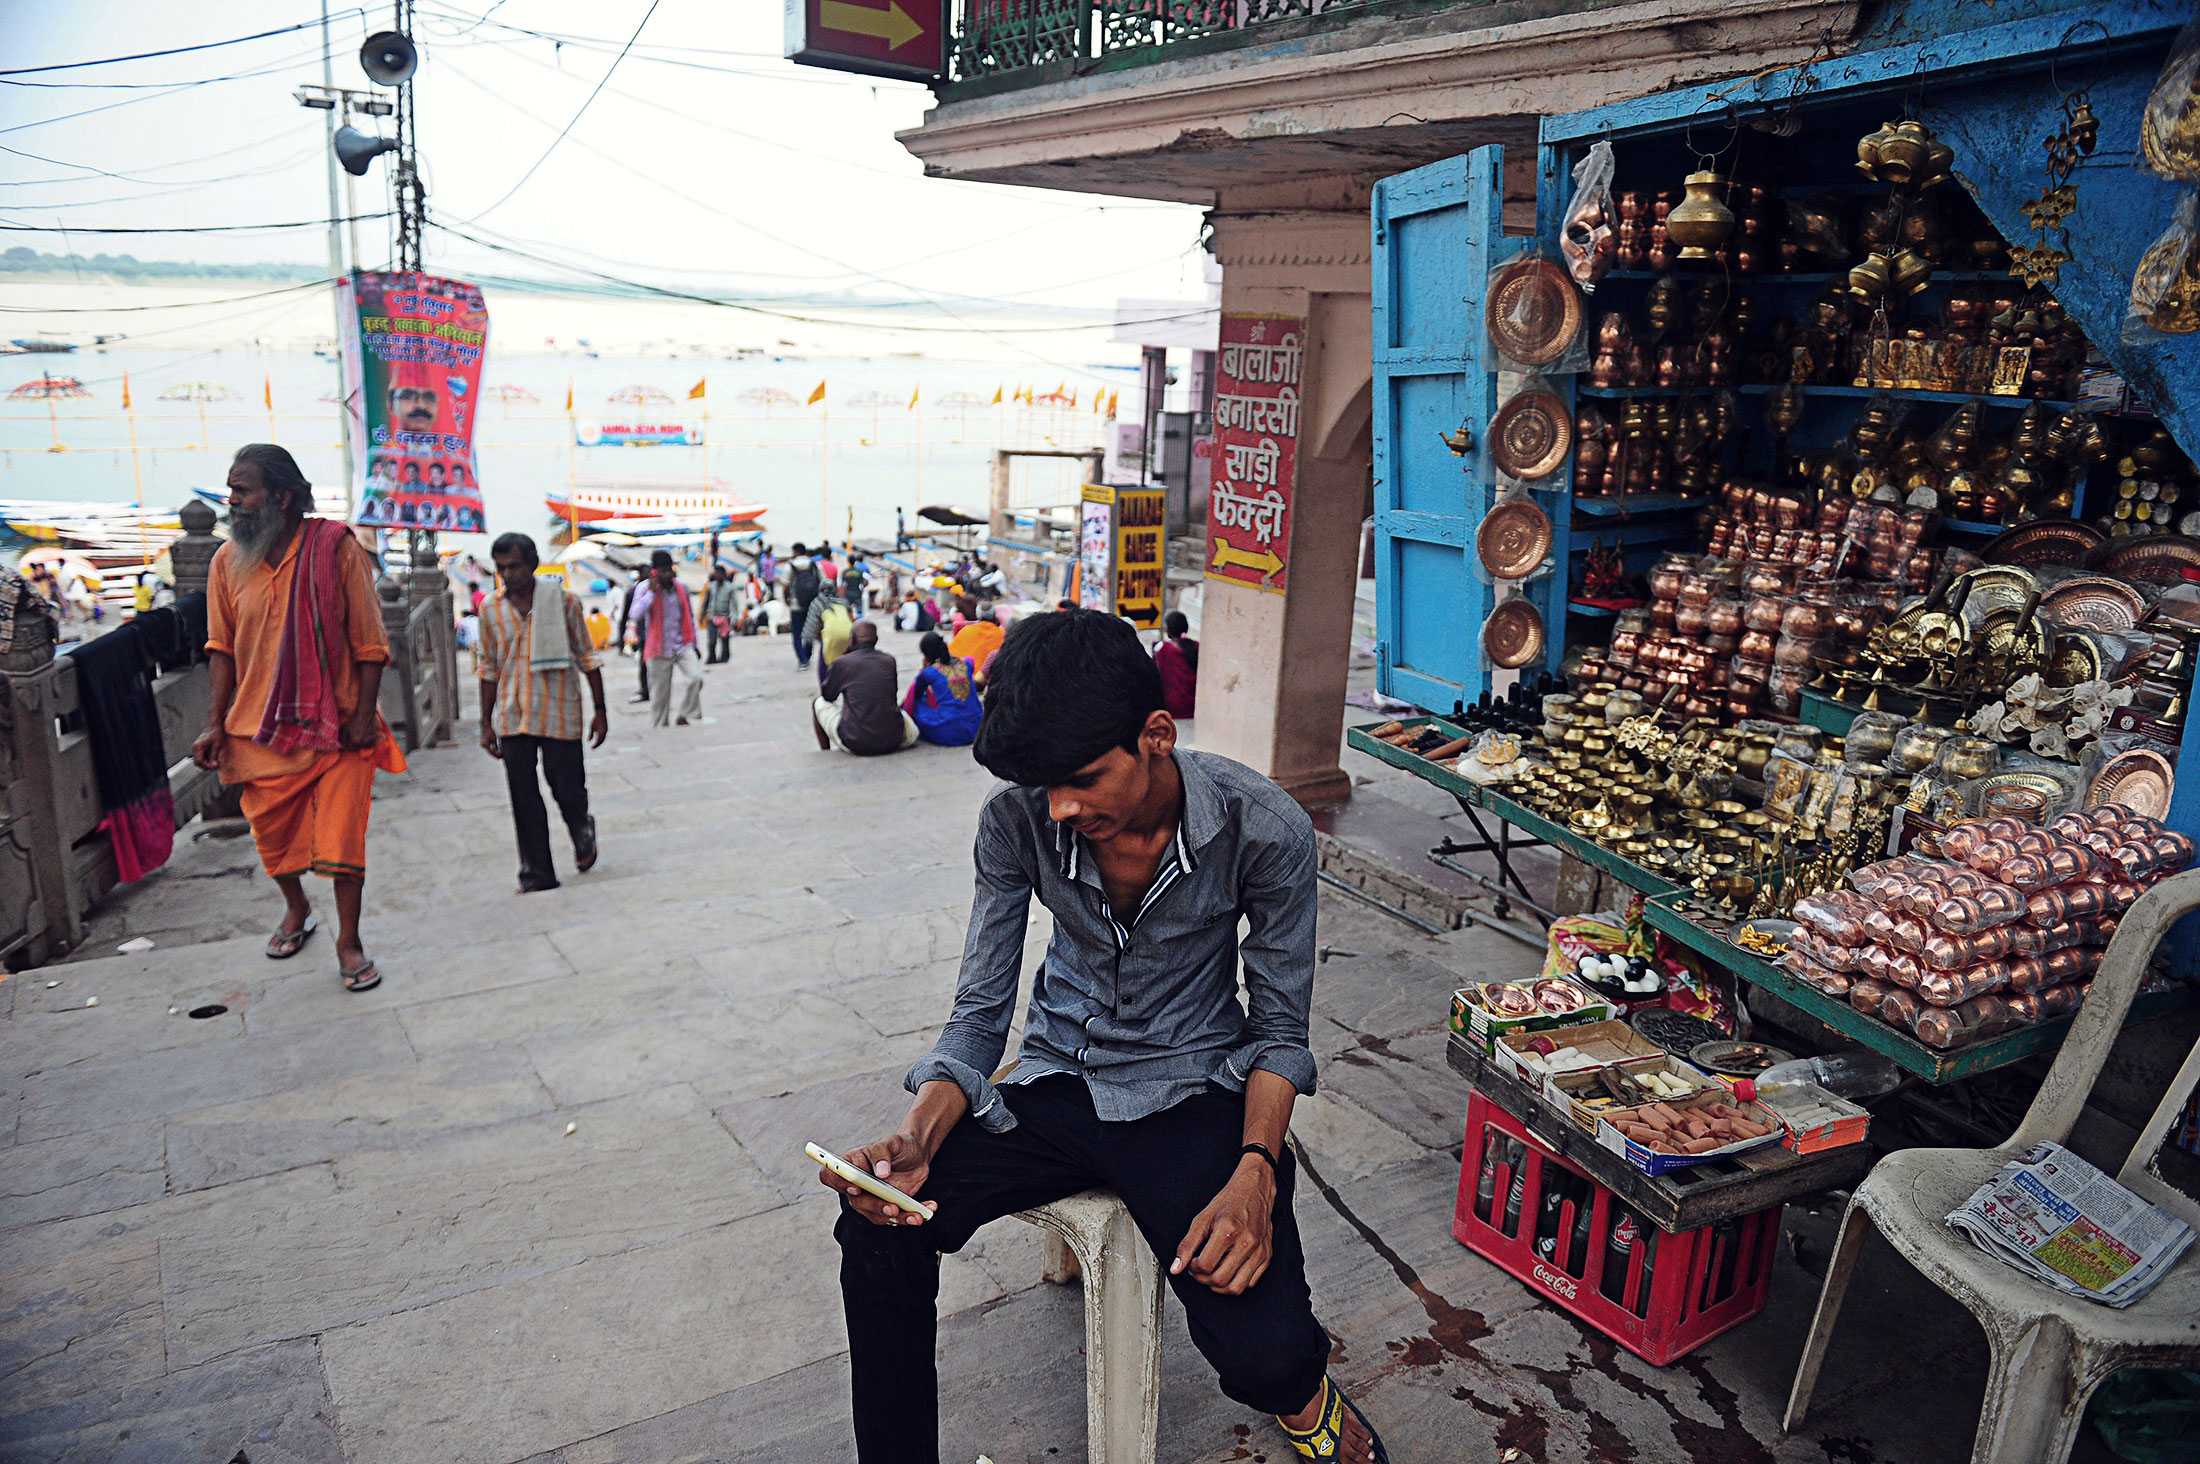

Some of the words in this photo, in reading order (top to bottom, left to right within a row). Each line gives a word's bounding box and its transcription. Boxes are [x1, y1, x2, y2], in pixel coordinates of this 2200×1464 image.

[1221, 332, 1303, 385] बालाजी
[1215, 388, 1299, 438] बनारसी
[1225, 438, 1280, 493] साड़ी
[1211, 480, 1286, 544] फैक्ट्री
[1982, 1199, 2010, 1229] फैट
[2015, 1228, 2038, 1247] गो
